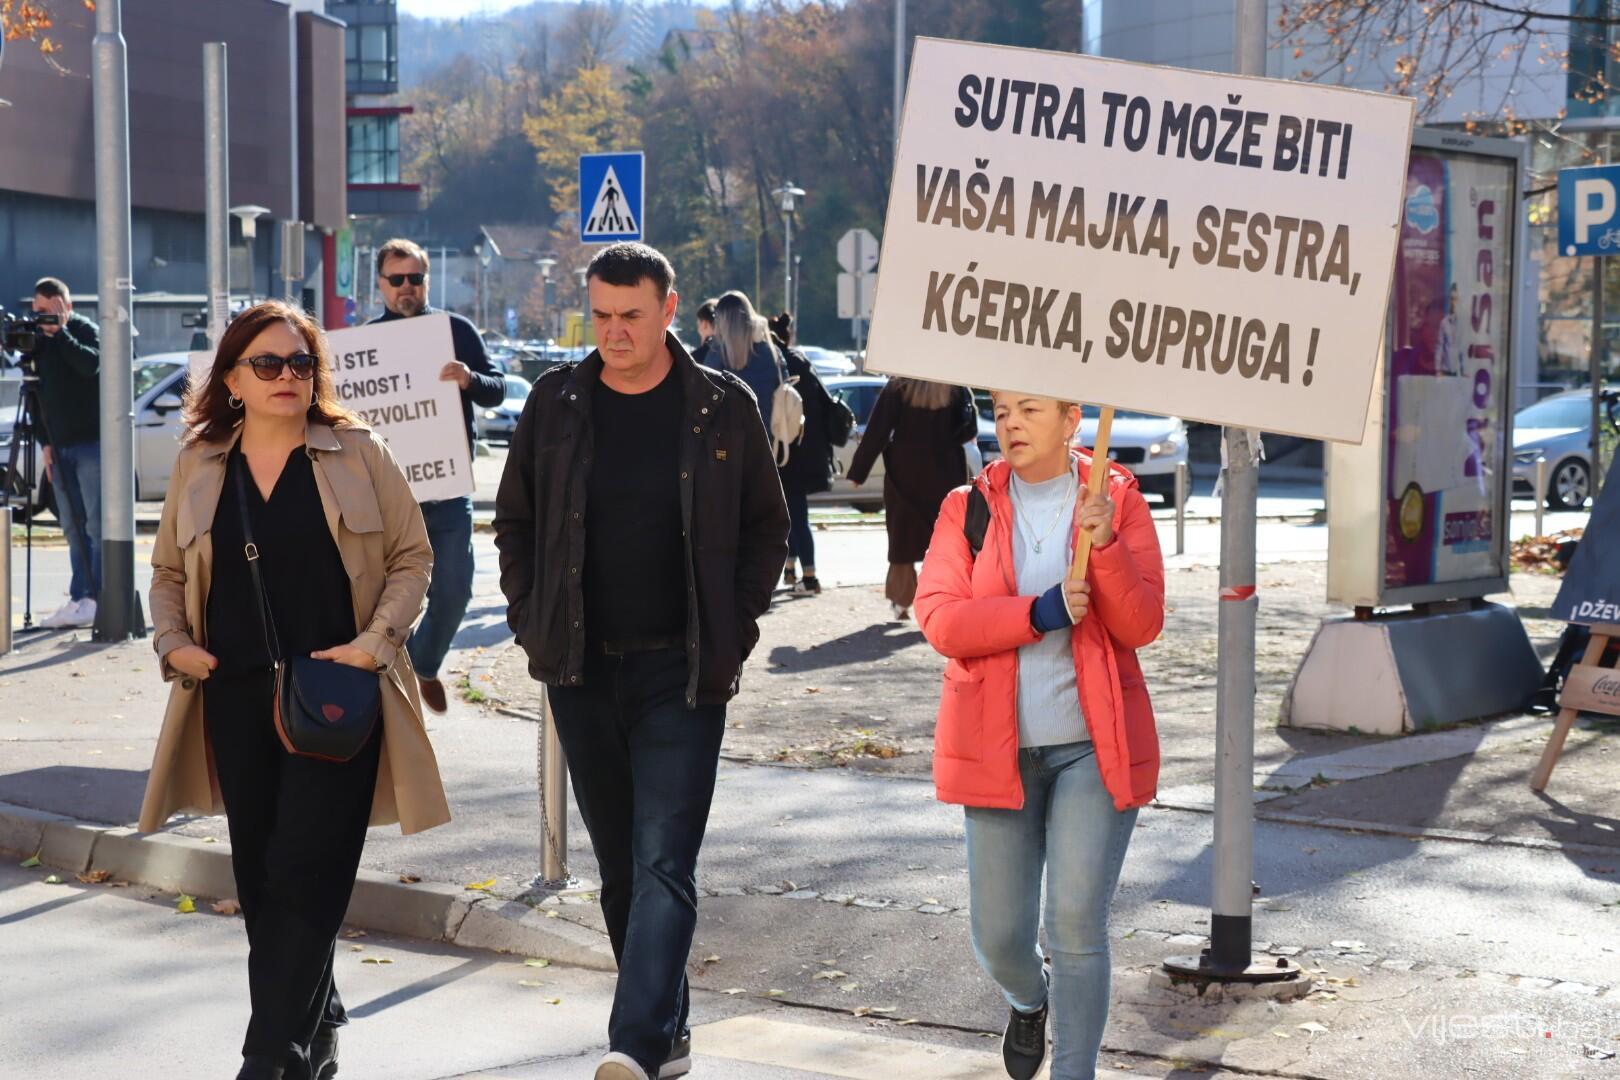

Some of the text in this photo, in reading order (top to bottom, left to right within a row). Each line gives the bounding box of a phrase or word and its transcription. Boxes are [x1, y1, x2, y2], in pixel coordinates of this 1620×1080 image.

[955, 74, 1353, 180] SUTRA TO MOŽE BITI
[916, 158, 1362, 297] VAŠA MAJKA, SESTRA,
[1575, 179, 1616, 244] P
[921, 261, 1321, 388] KĆERKA, SUPRUGA !
[343, 348, 379, 370] STE
[404, 372, 411, 390] !
[449, 458, 456, 476] !
